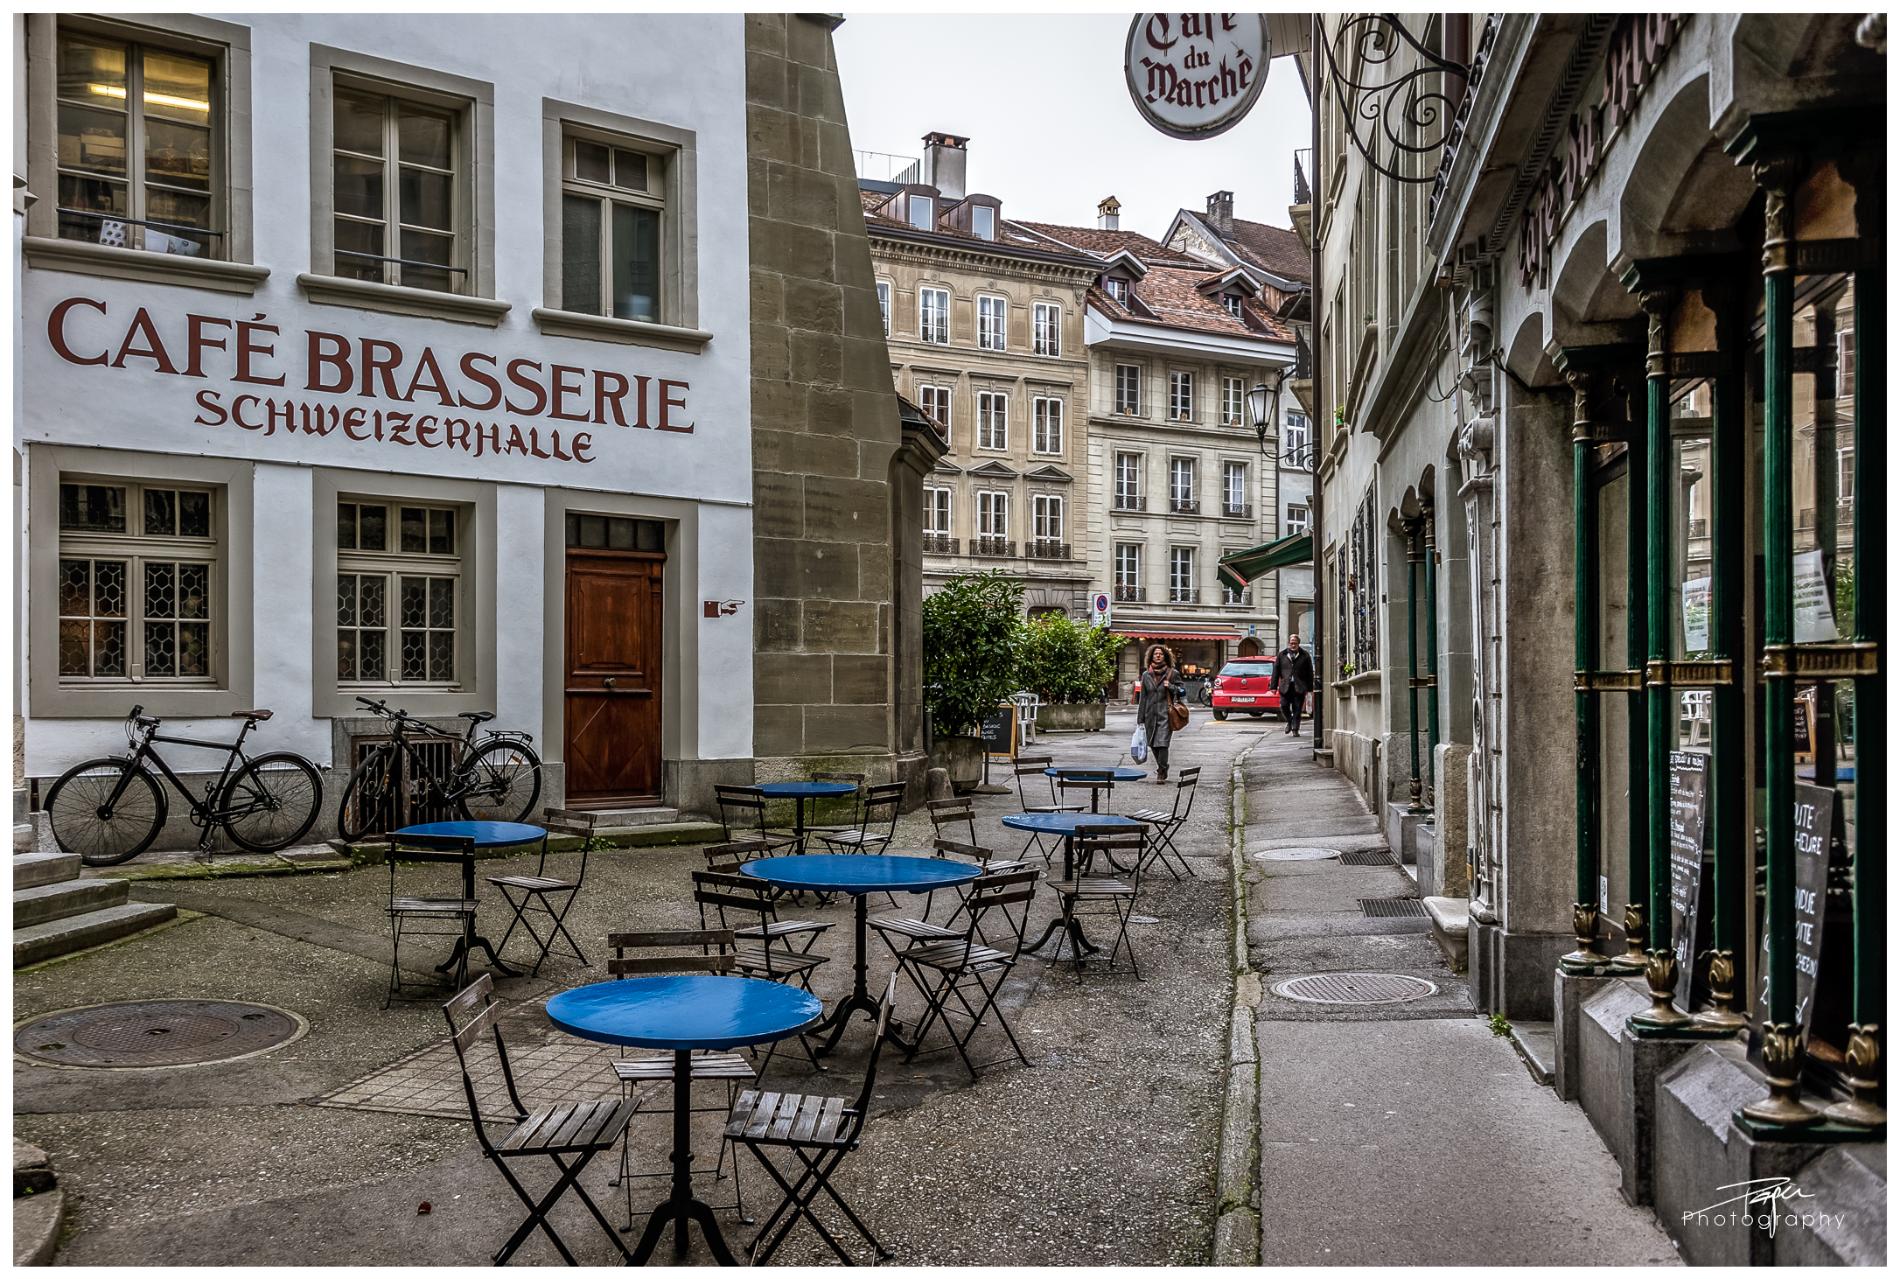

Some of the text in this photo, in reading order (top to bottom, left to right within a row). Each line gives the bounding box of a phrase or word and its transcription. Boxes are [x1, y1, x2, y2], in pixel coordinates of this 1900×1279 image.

[1139, 49, 1253, 110] Marché
[1184, 44, 1212, 70] du
[47, 297, 696, 435] CAFÉ BRASSERIE
[194, 390, 597, 464] SCHWEIZERHALLE
[1794, 801, 1815, 830] UTE
